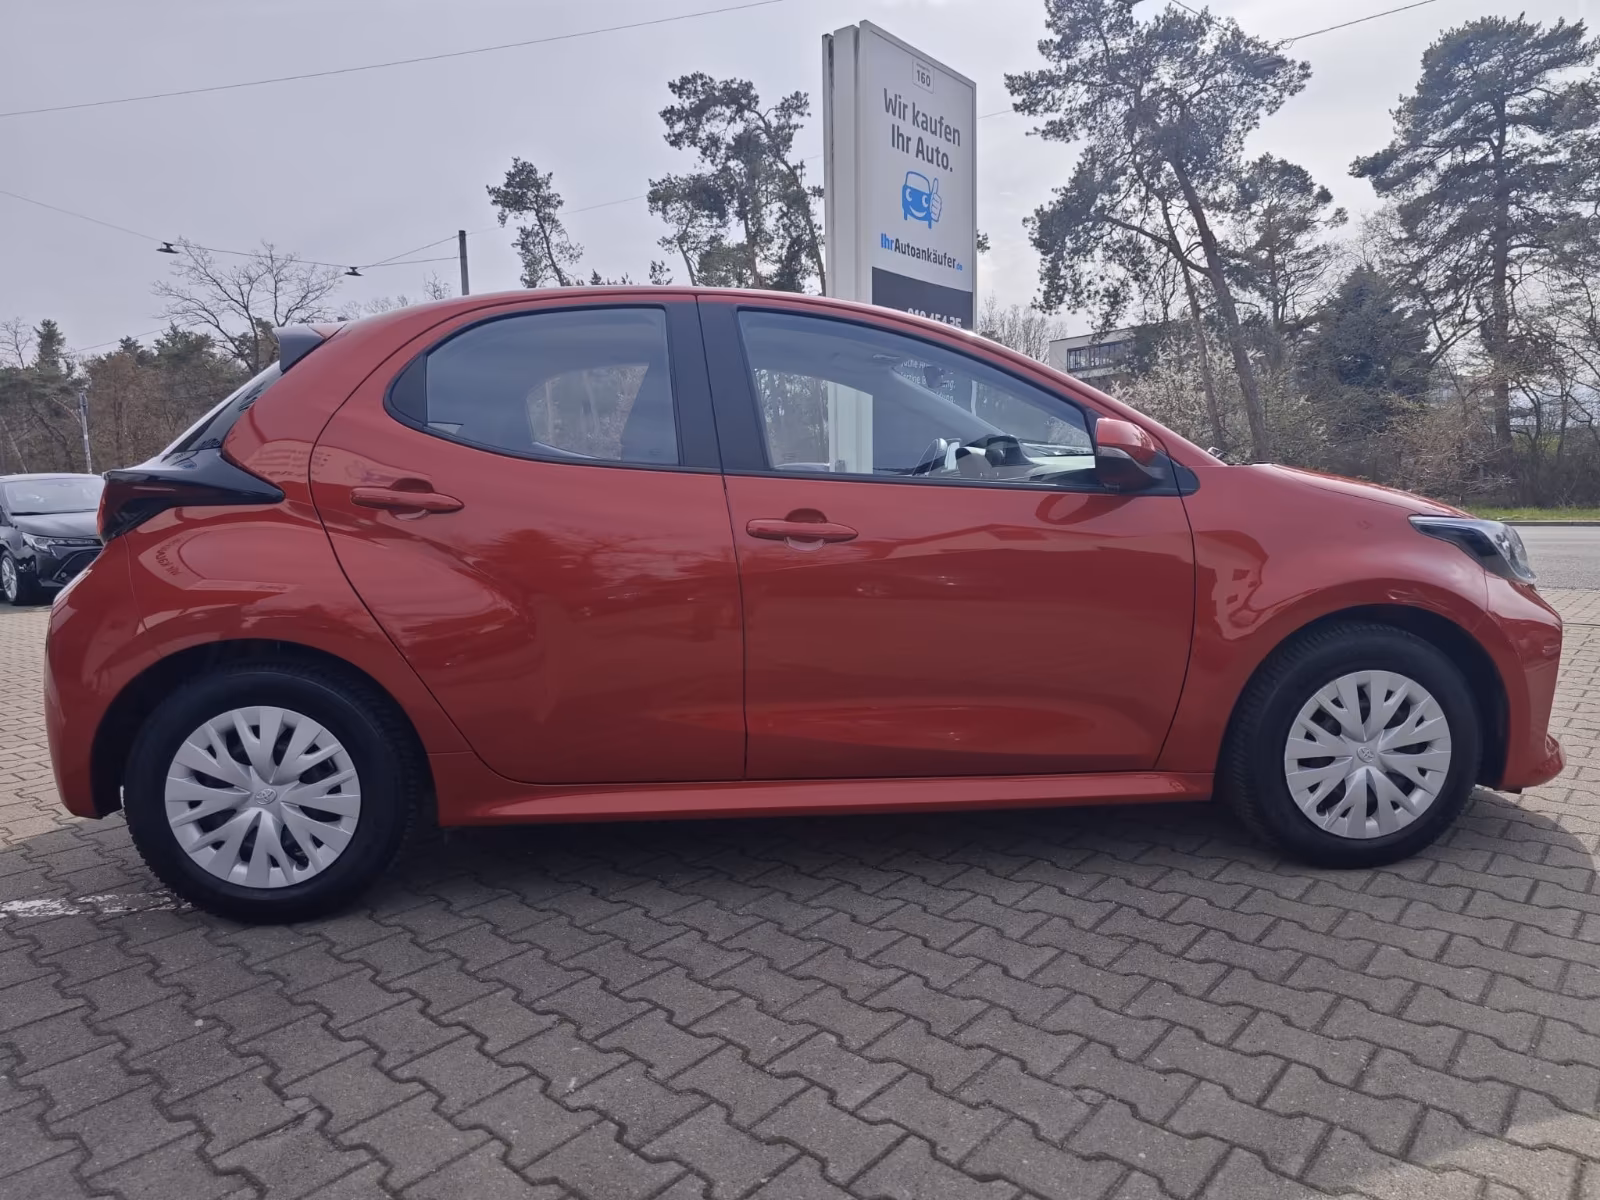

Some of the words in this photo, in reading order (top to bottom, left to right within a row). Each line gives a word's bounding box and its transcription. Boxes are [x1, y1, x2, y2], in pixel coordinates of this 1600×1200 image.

[917, 70, 931, 87] 160
[884, 88, 908, 121] Wir
[912, 102, 961, 147] kaufen
[891, 124, 911, 154] Ihr
[915, 136, 953, 172] Auto.
